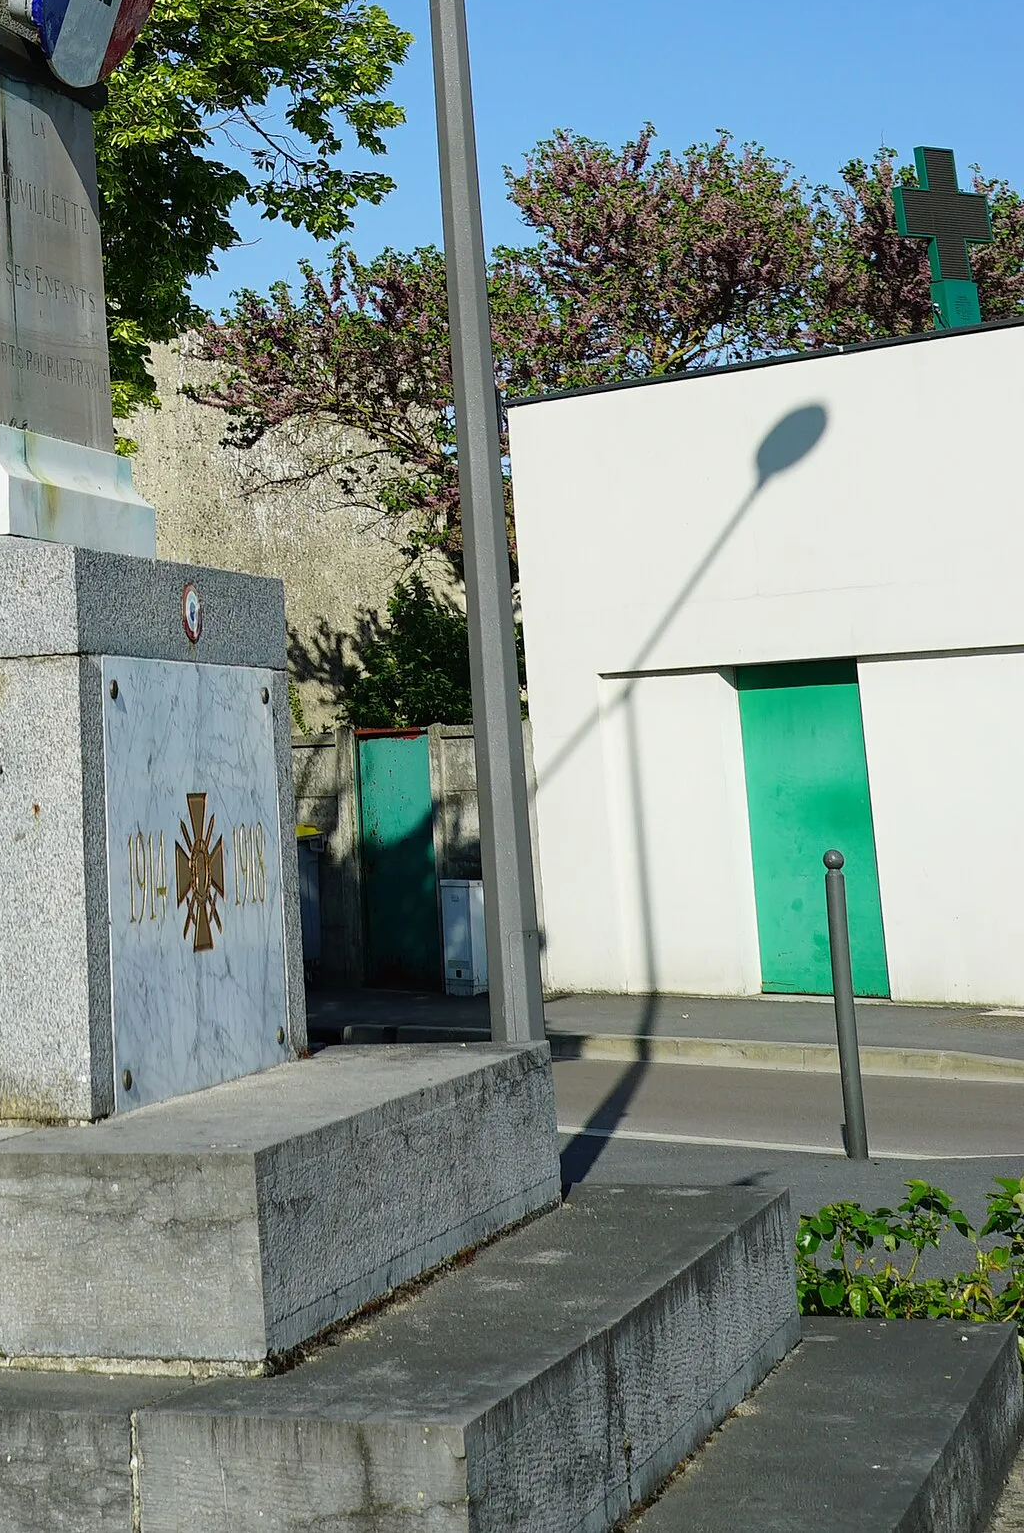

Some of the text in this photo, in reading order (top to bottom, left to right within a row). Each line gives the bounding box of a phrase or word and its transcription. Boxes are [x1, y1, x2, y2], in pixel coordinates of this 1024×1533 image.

[30, 113, 46, 140] LA
[5, 260, 31, 290] SES
[36, 265, 96, 313] ENFANTS
[128, 820, 266, 925] 1914 1918
